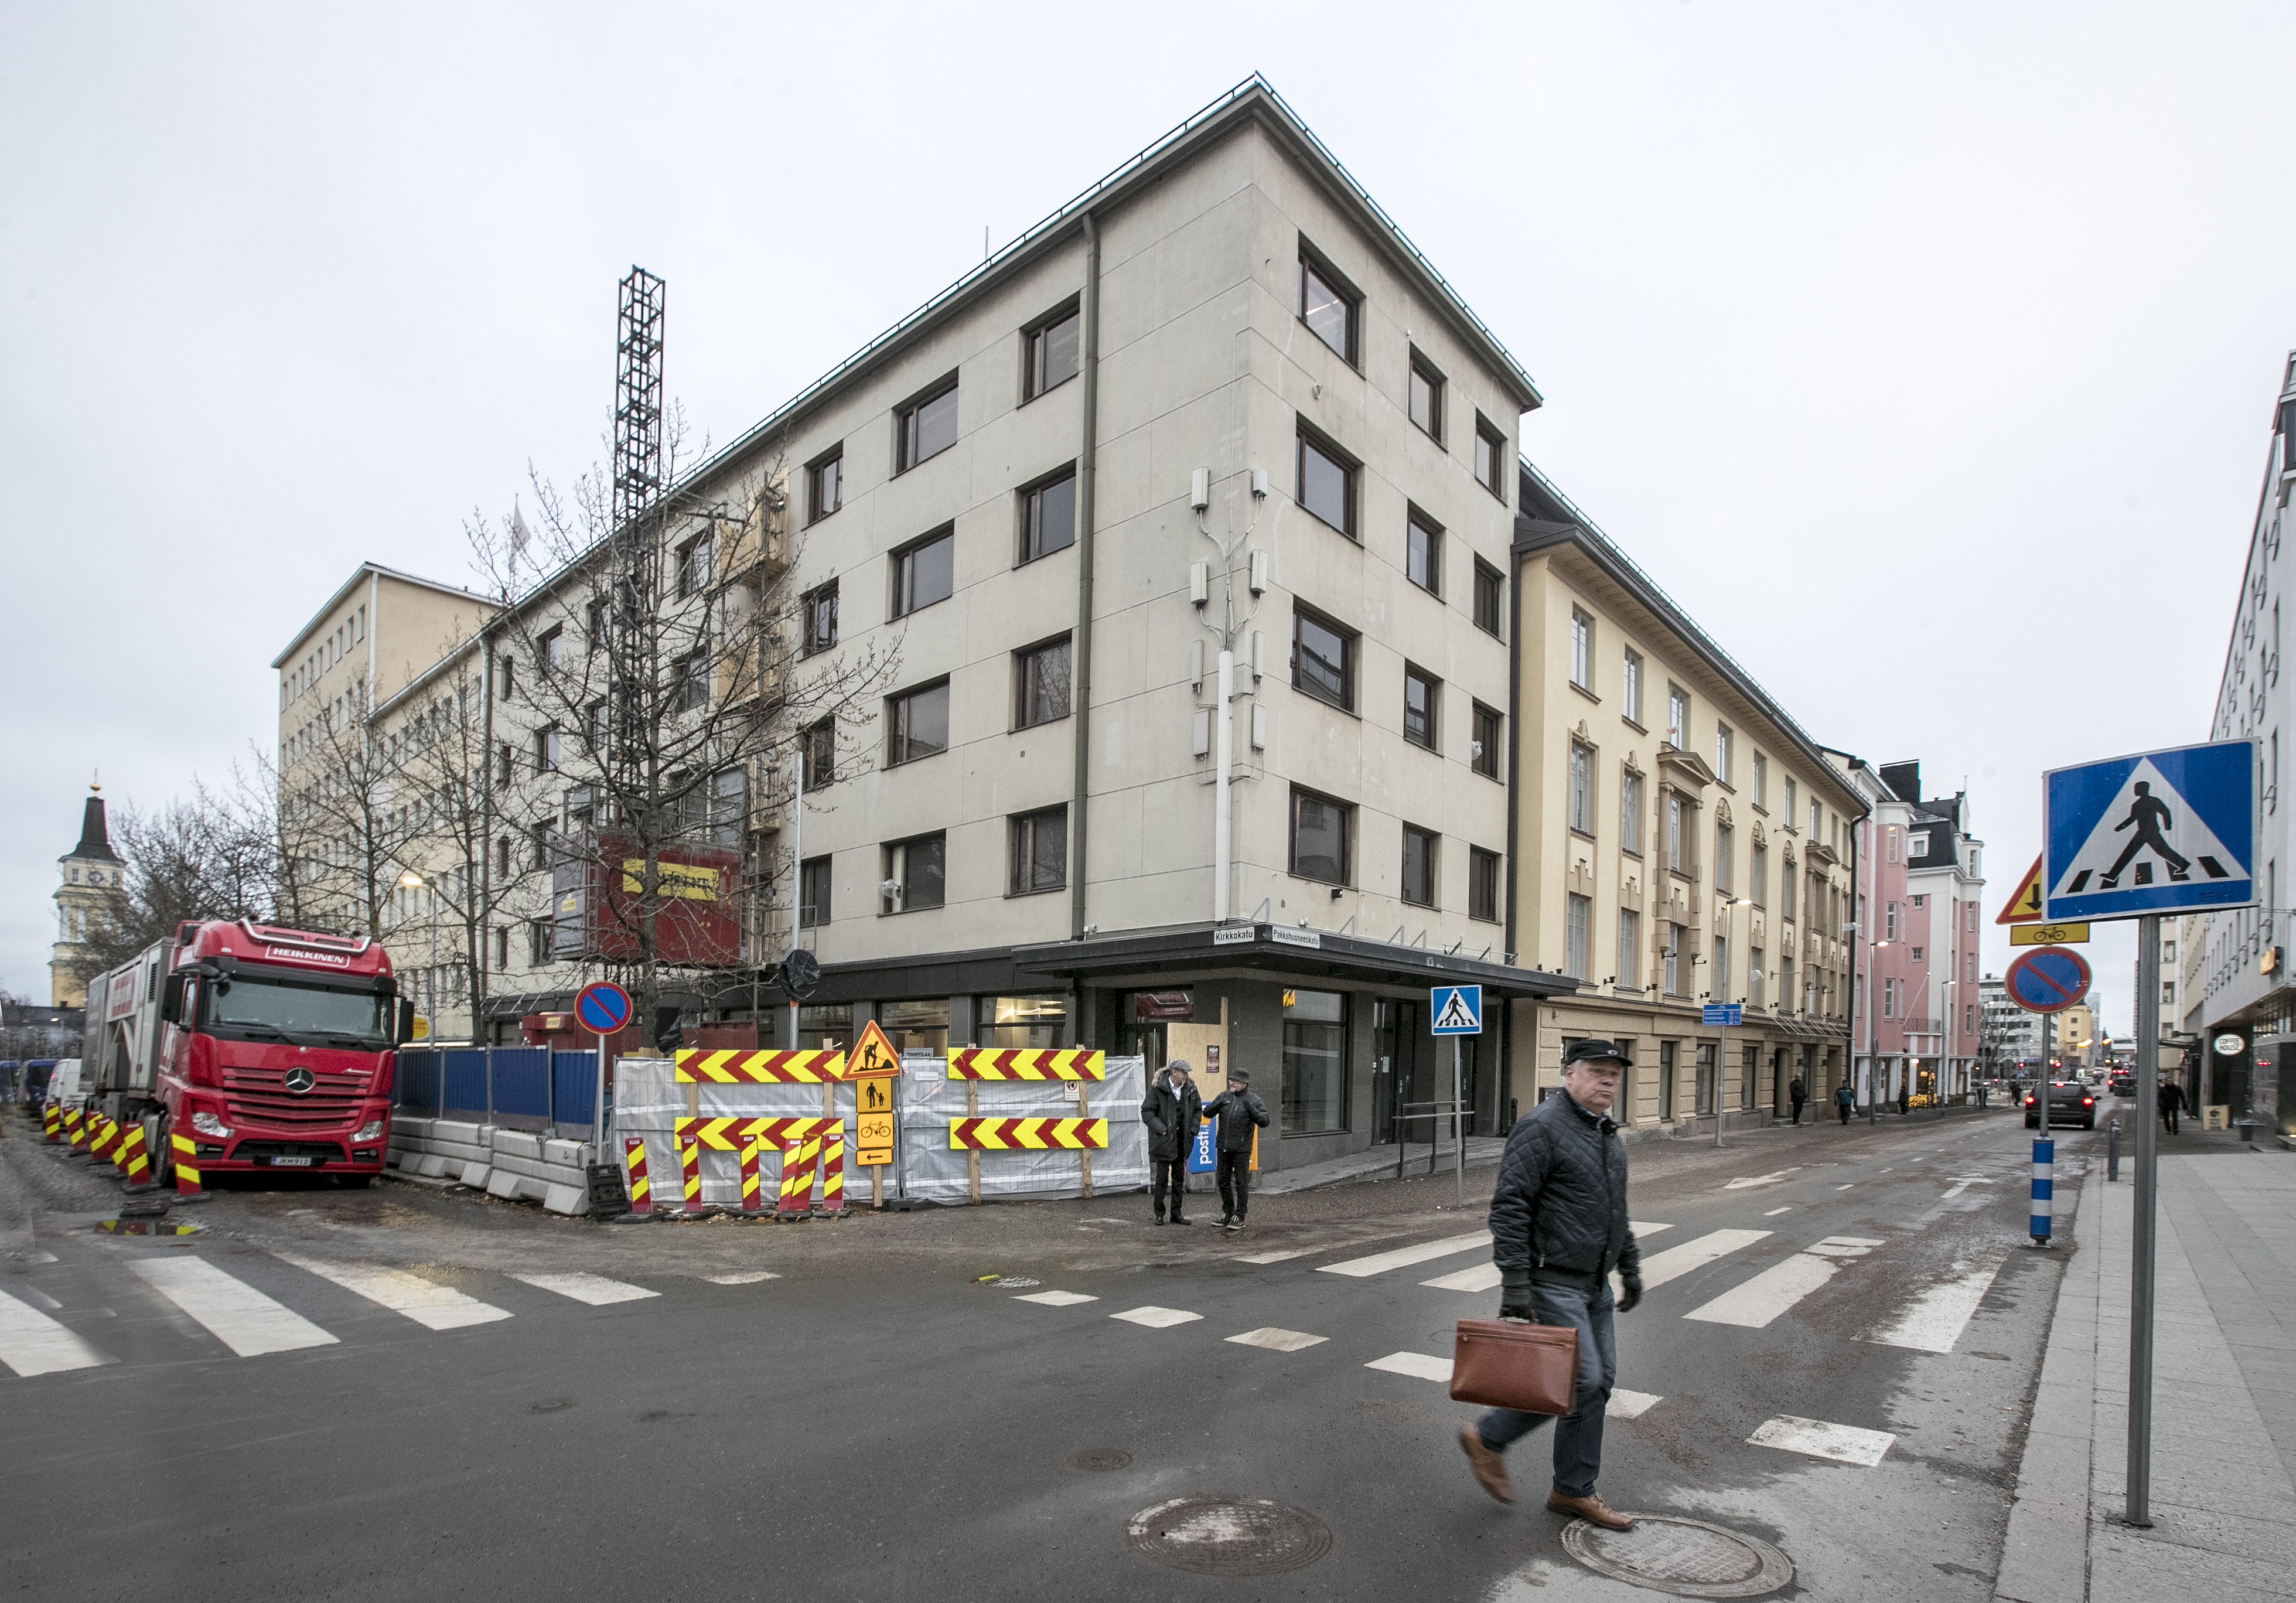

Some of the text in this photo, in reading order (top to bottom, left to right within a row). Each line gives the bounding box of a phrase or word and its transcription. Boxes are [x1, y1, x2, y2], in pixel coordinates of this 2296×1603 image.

[1216, 930, 1253, 941] Kirkkokatu
[1273, 929, 1319, 945] Pakkahuoneenkatu
[273, 947, 344, 964] HEIKKINEN
[1197, 1131, 1212, 1165] posti
